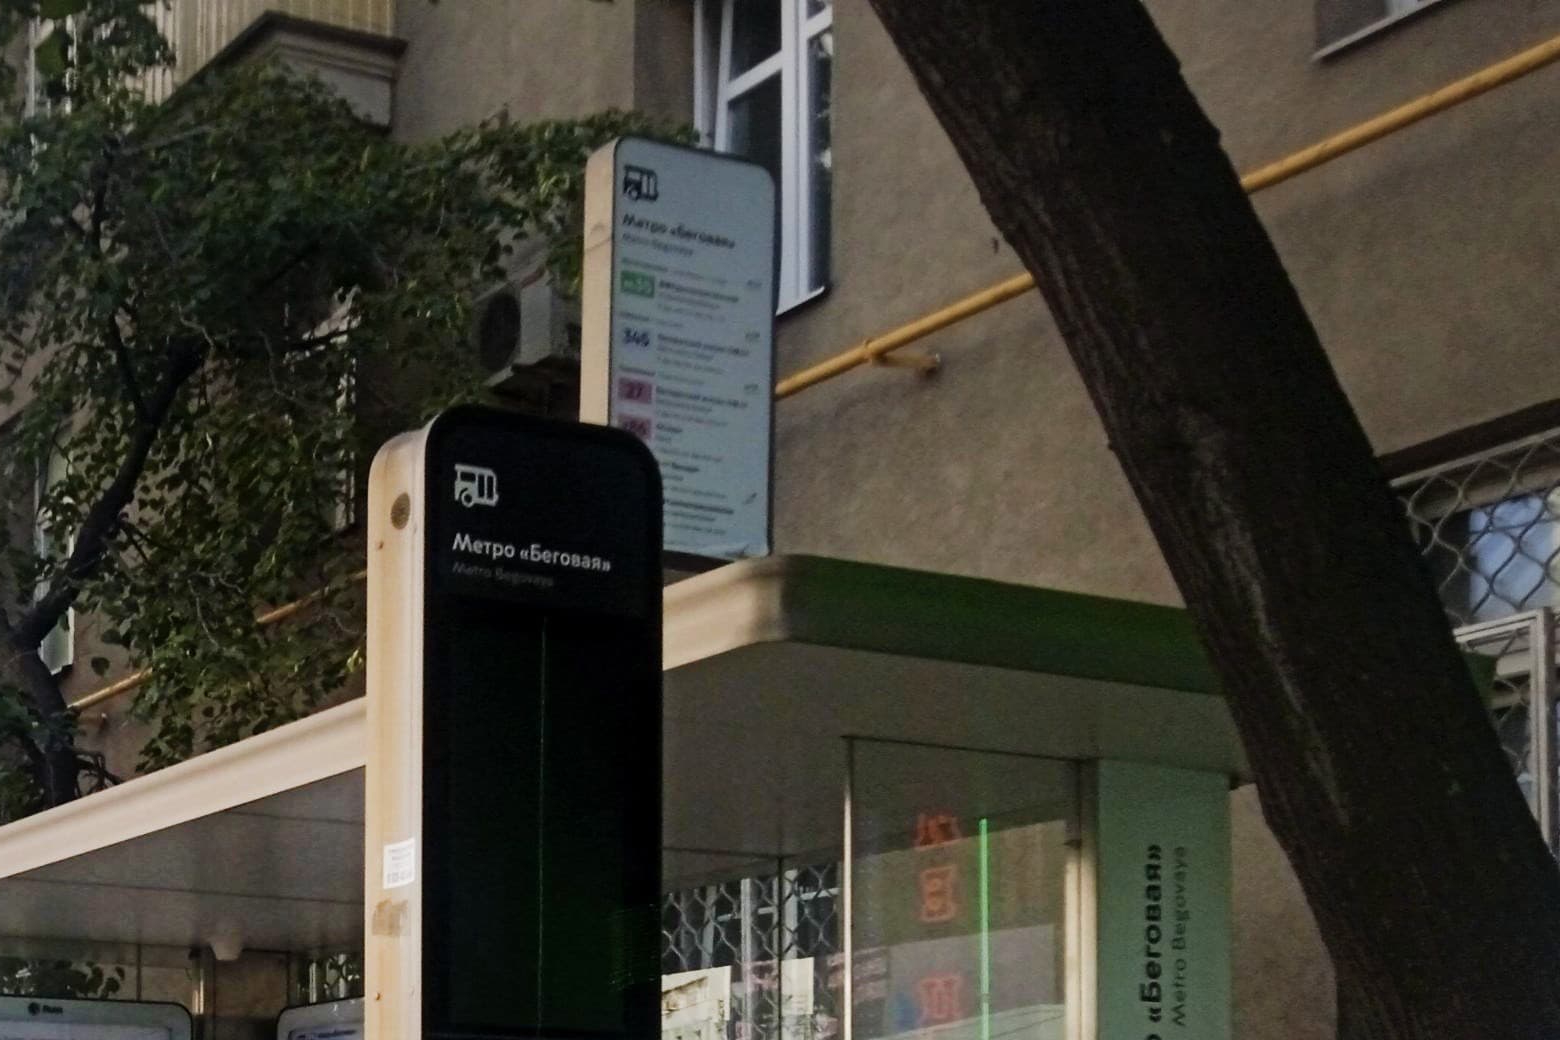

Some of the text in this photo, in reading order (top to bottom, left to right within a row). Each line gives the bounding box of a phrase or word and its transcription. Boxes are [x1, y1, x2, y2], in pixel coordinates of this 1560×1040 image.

[452, 532, 612, 573] Метро «Беговая»
[1139, 844, 1163, 1025] «Беговая»
[1172, 845, 1191, 1028] Metro Begovaya
